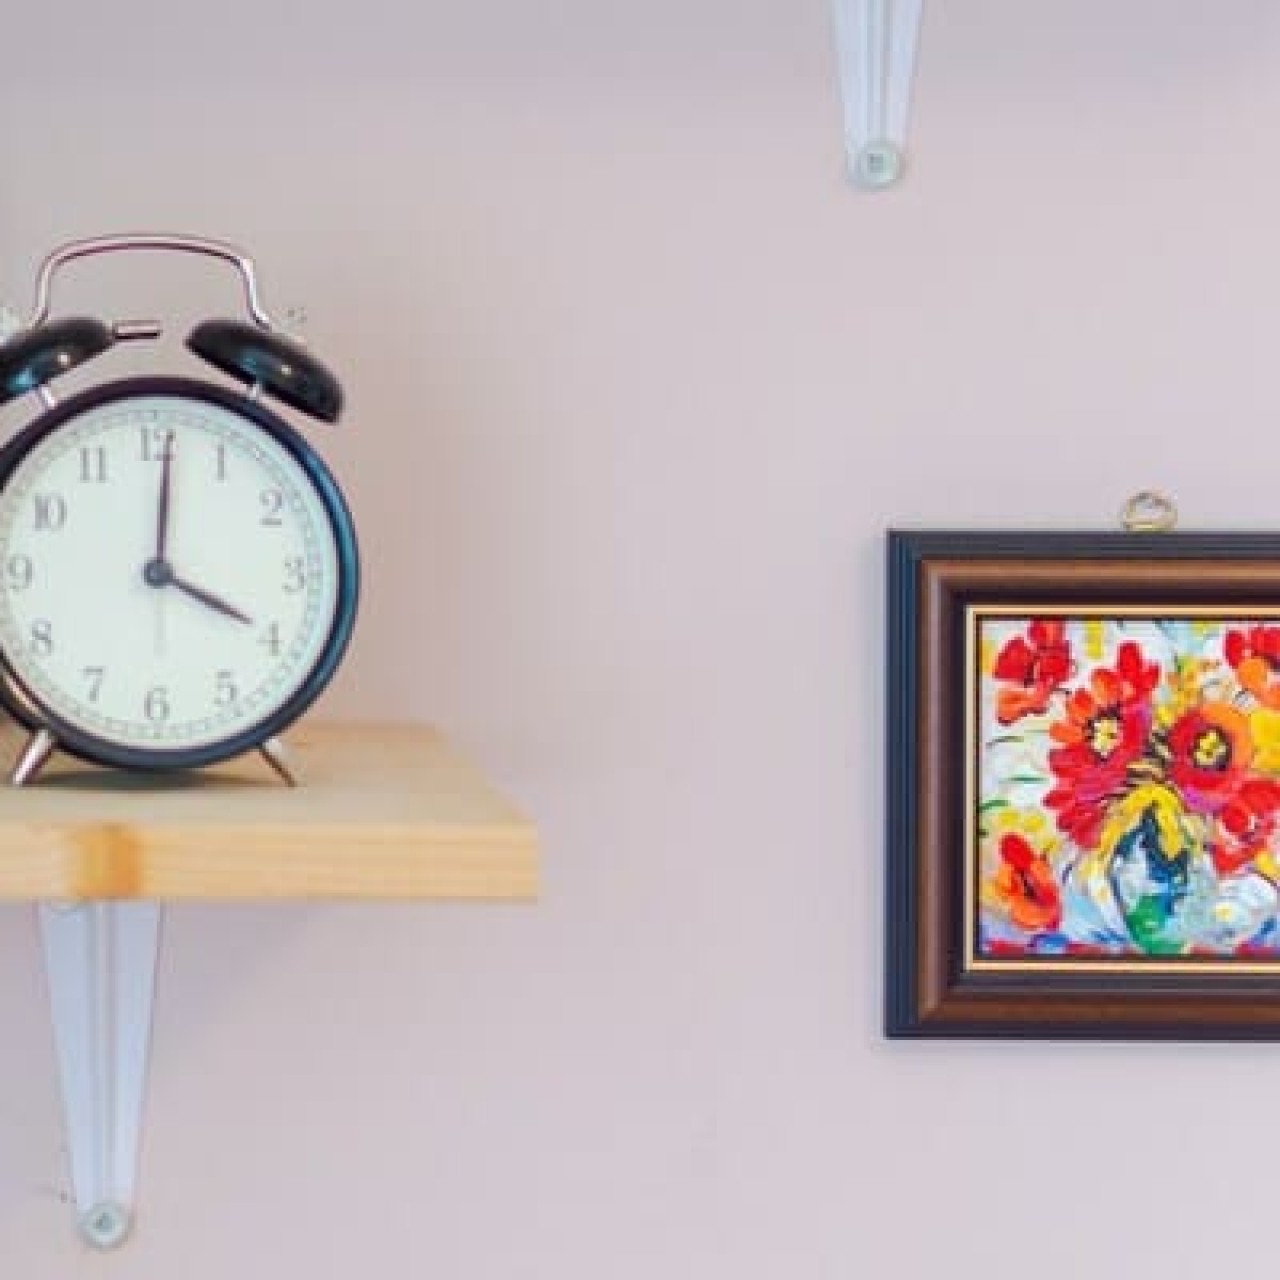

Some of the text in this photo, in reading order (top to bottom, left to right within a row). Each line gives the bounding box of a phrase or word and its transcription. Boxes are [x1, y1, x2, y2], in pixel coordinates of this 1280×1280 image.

[79, 446, 109, 483] 11
[216, 444, 228, 481] 1
[33, 493, 67, 531] 10
[259, 489, 284, 528] 2
[7, 554, 33, 591] 9
[282, 557, 306, 593] 3
[29, 620, 53, 655] 8
[257, 622, 282, 657] 4
[81, 666, 105, 703] 7
[213, 670, 238, 706] 5
[143, 687, 171, 722] 6
